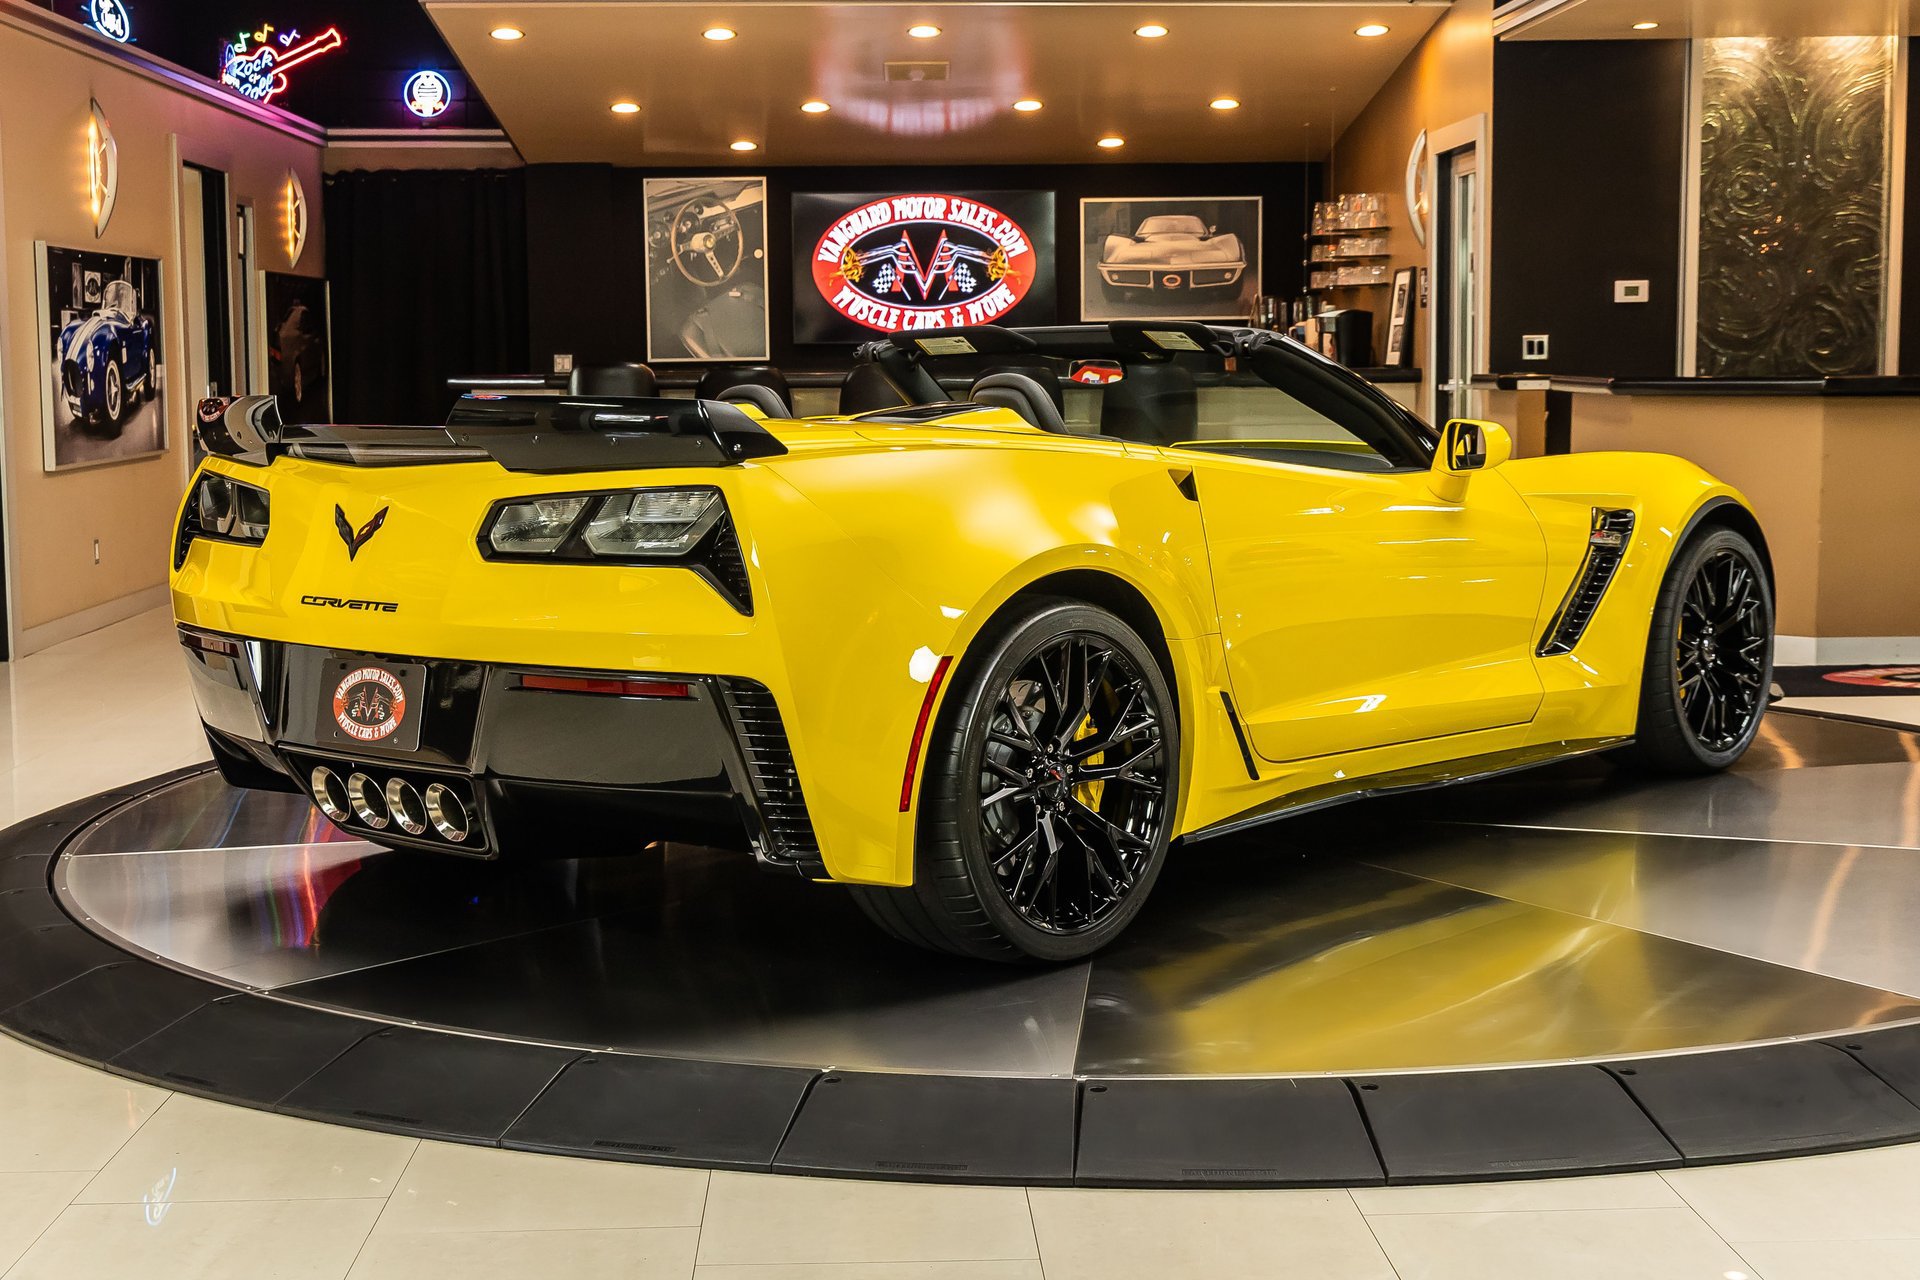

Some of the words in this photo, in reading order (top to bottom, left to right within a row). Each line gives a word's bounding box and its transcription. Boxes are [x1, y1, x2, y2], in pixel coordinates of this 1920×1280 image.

[233, 49, 274, 79] Rock
[817, 201, 892, 264] VANGUARD
[892, 197, 947, 220] MOTOR
[947, 199, 1029, 258] SALES.COM
[832, 285, 901, 330] MUSCLE
[902, 309, 946, 331] CARS
[950, 306, 964, 327] &
[965, 283, 1017, 324] MORE
[301, 596, 399, 613] CORVETTE
[336, 670, 362, 700] VANGUARD
[362, 668, 380, 680] MOTOR
[380, 671, 404, 703] SALES.COM
[337, 712, 359, 735] MUSCLE
[358, 726, 373, 739] CARS
[374, 727, 379, 738] &
[380, 716, 397, 737] MORE
